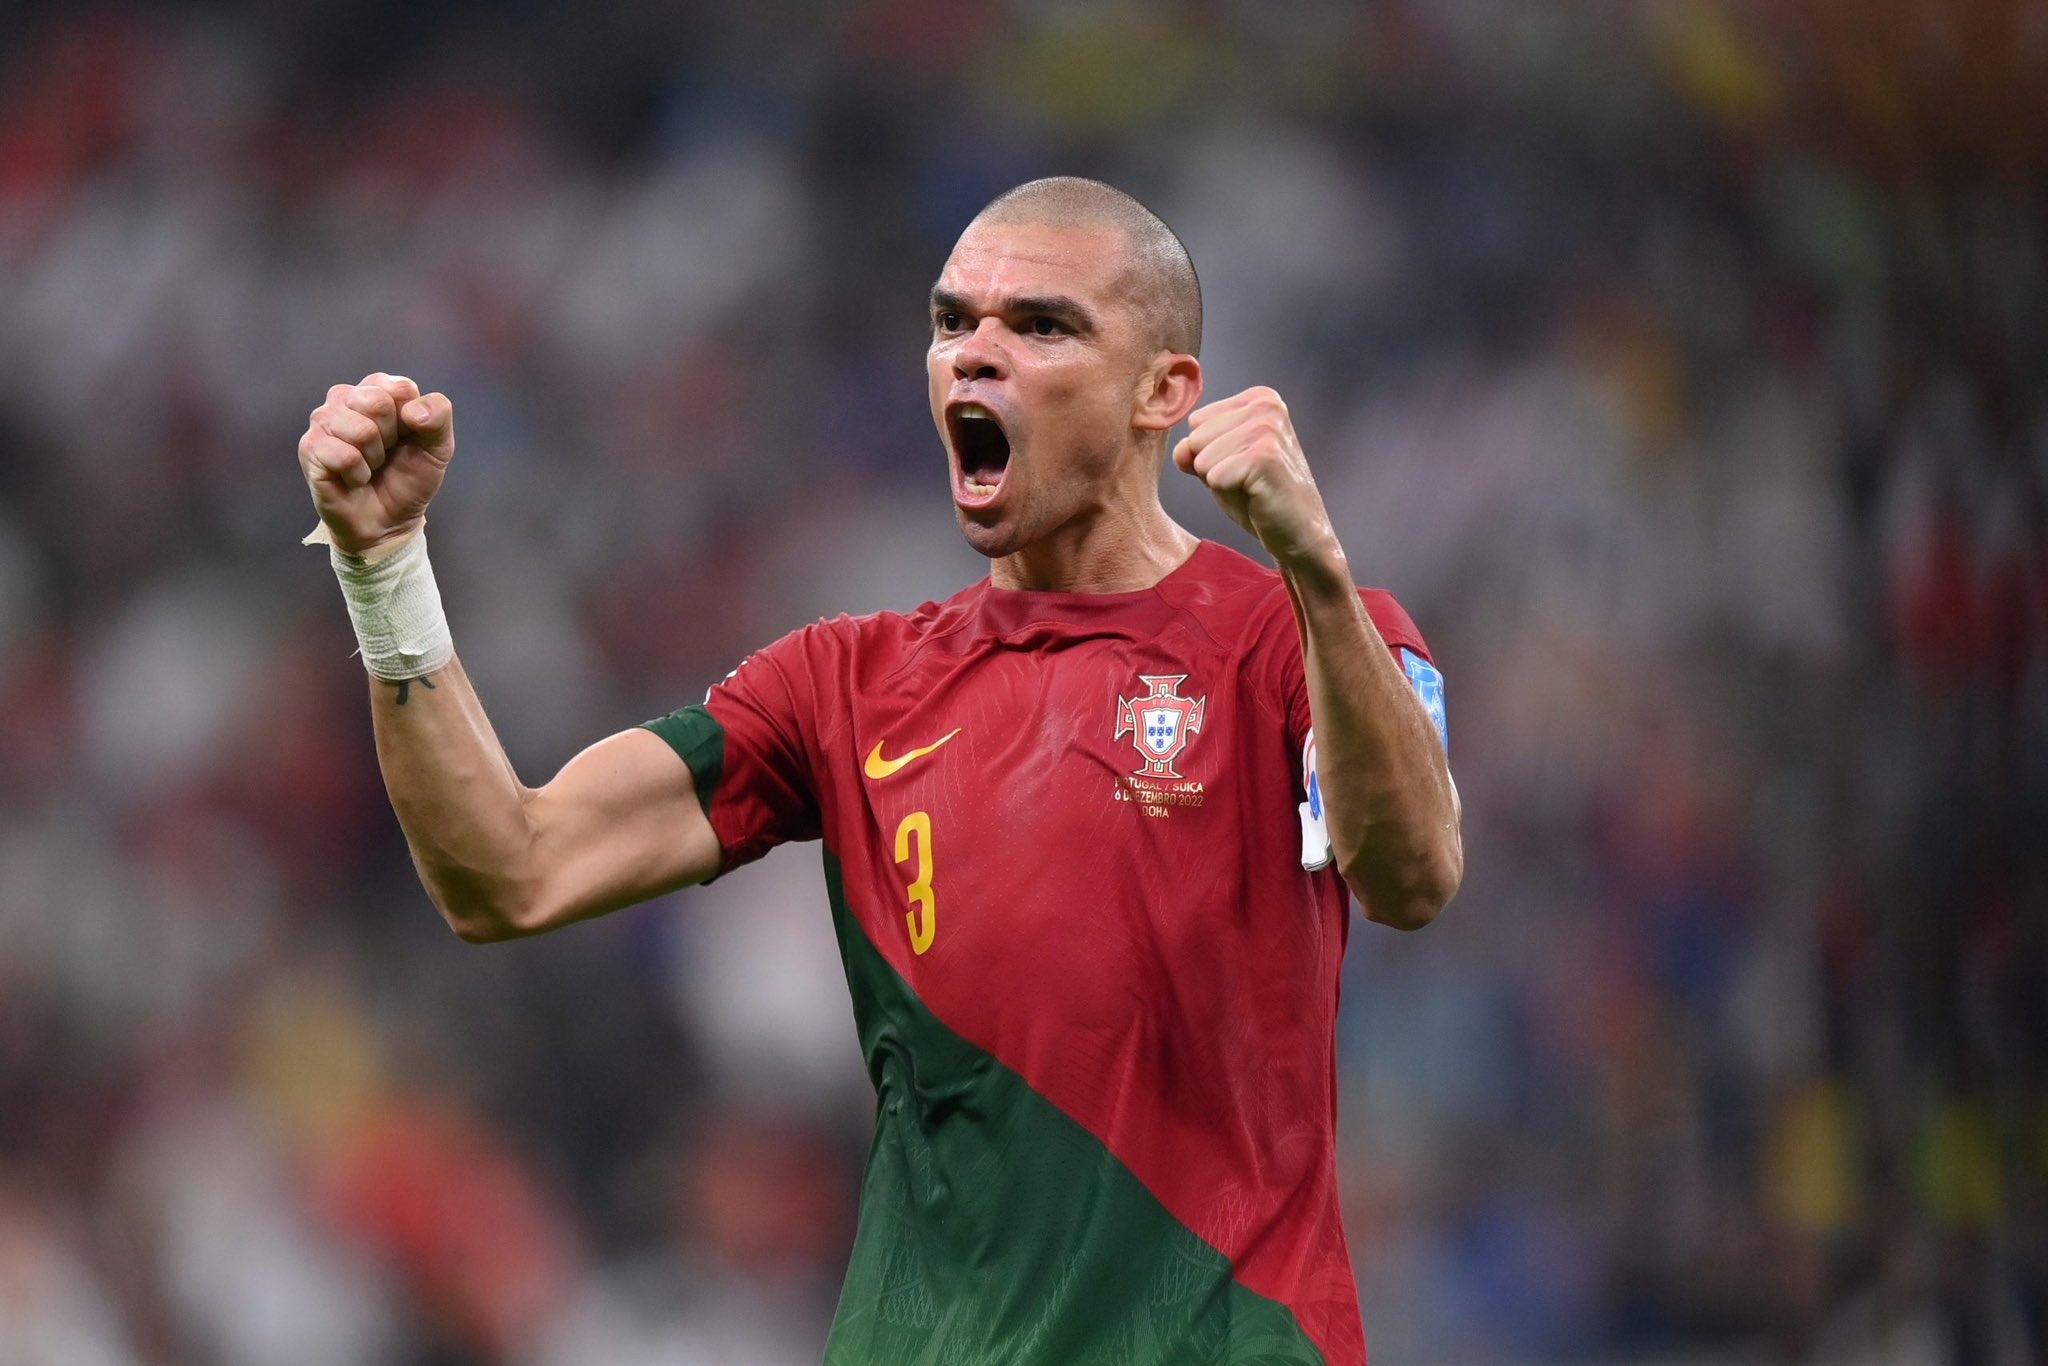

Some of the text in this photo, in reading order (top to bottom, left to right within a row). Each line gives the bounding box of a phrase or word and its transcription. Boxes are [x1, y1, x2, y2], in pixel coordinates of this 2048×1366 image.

[1115, 777, 1161, 790] PTUGAL
[1115, 790, 1121, 800] 6
[1134, 790, 1177, 805] EZEMBRO
[1178, 794, 1204, 807] 2022
[1143, 806, 1169, 817] DOHA
[895, 812, 935, 955] 3
